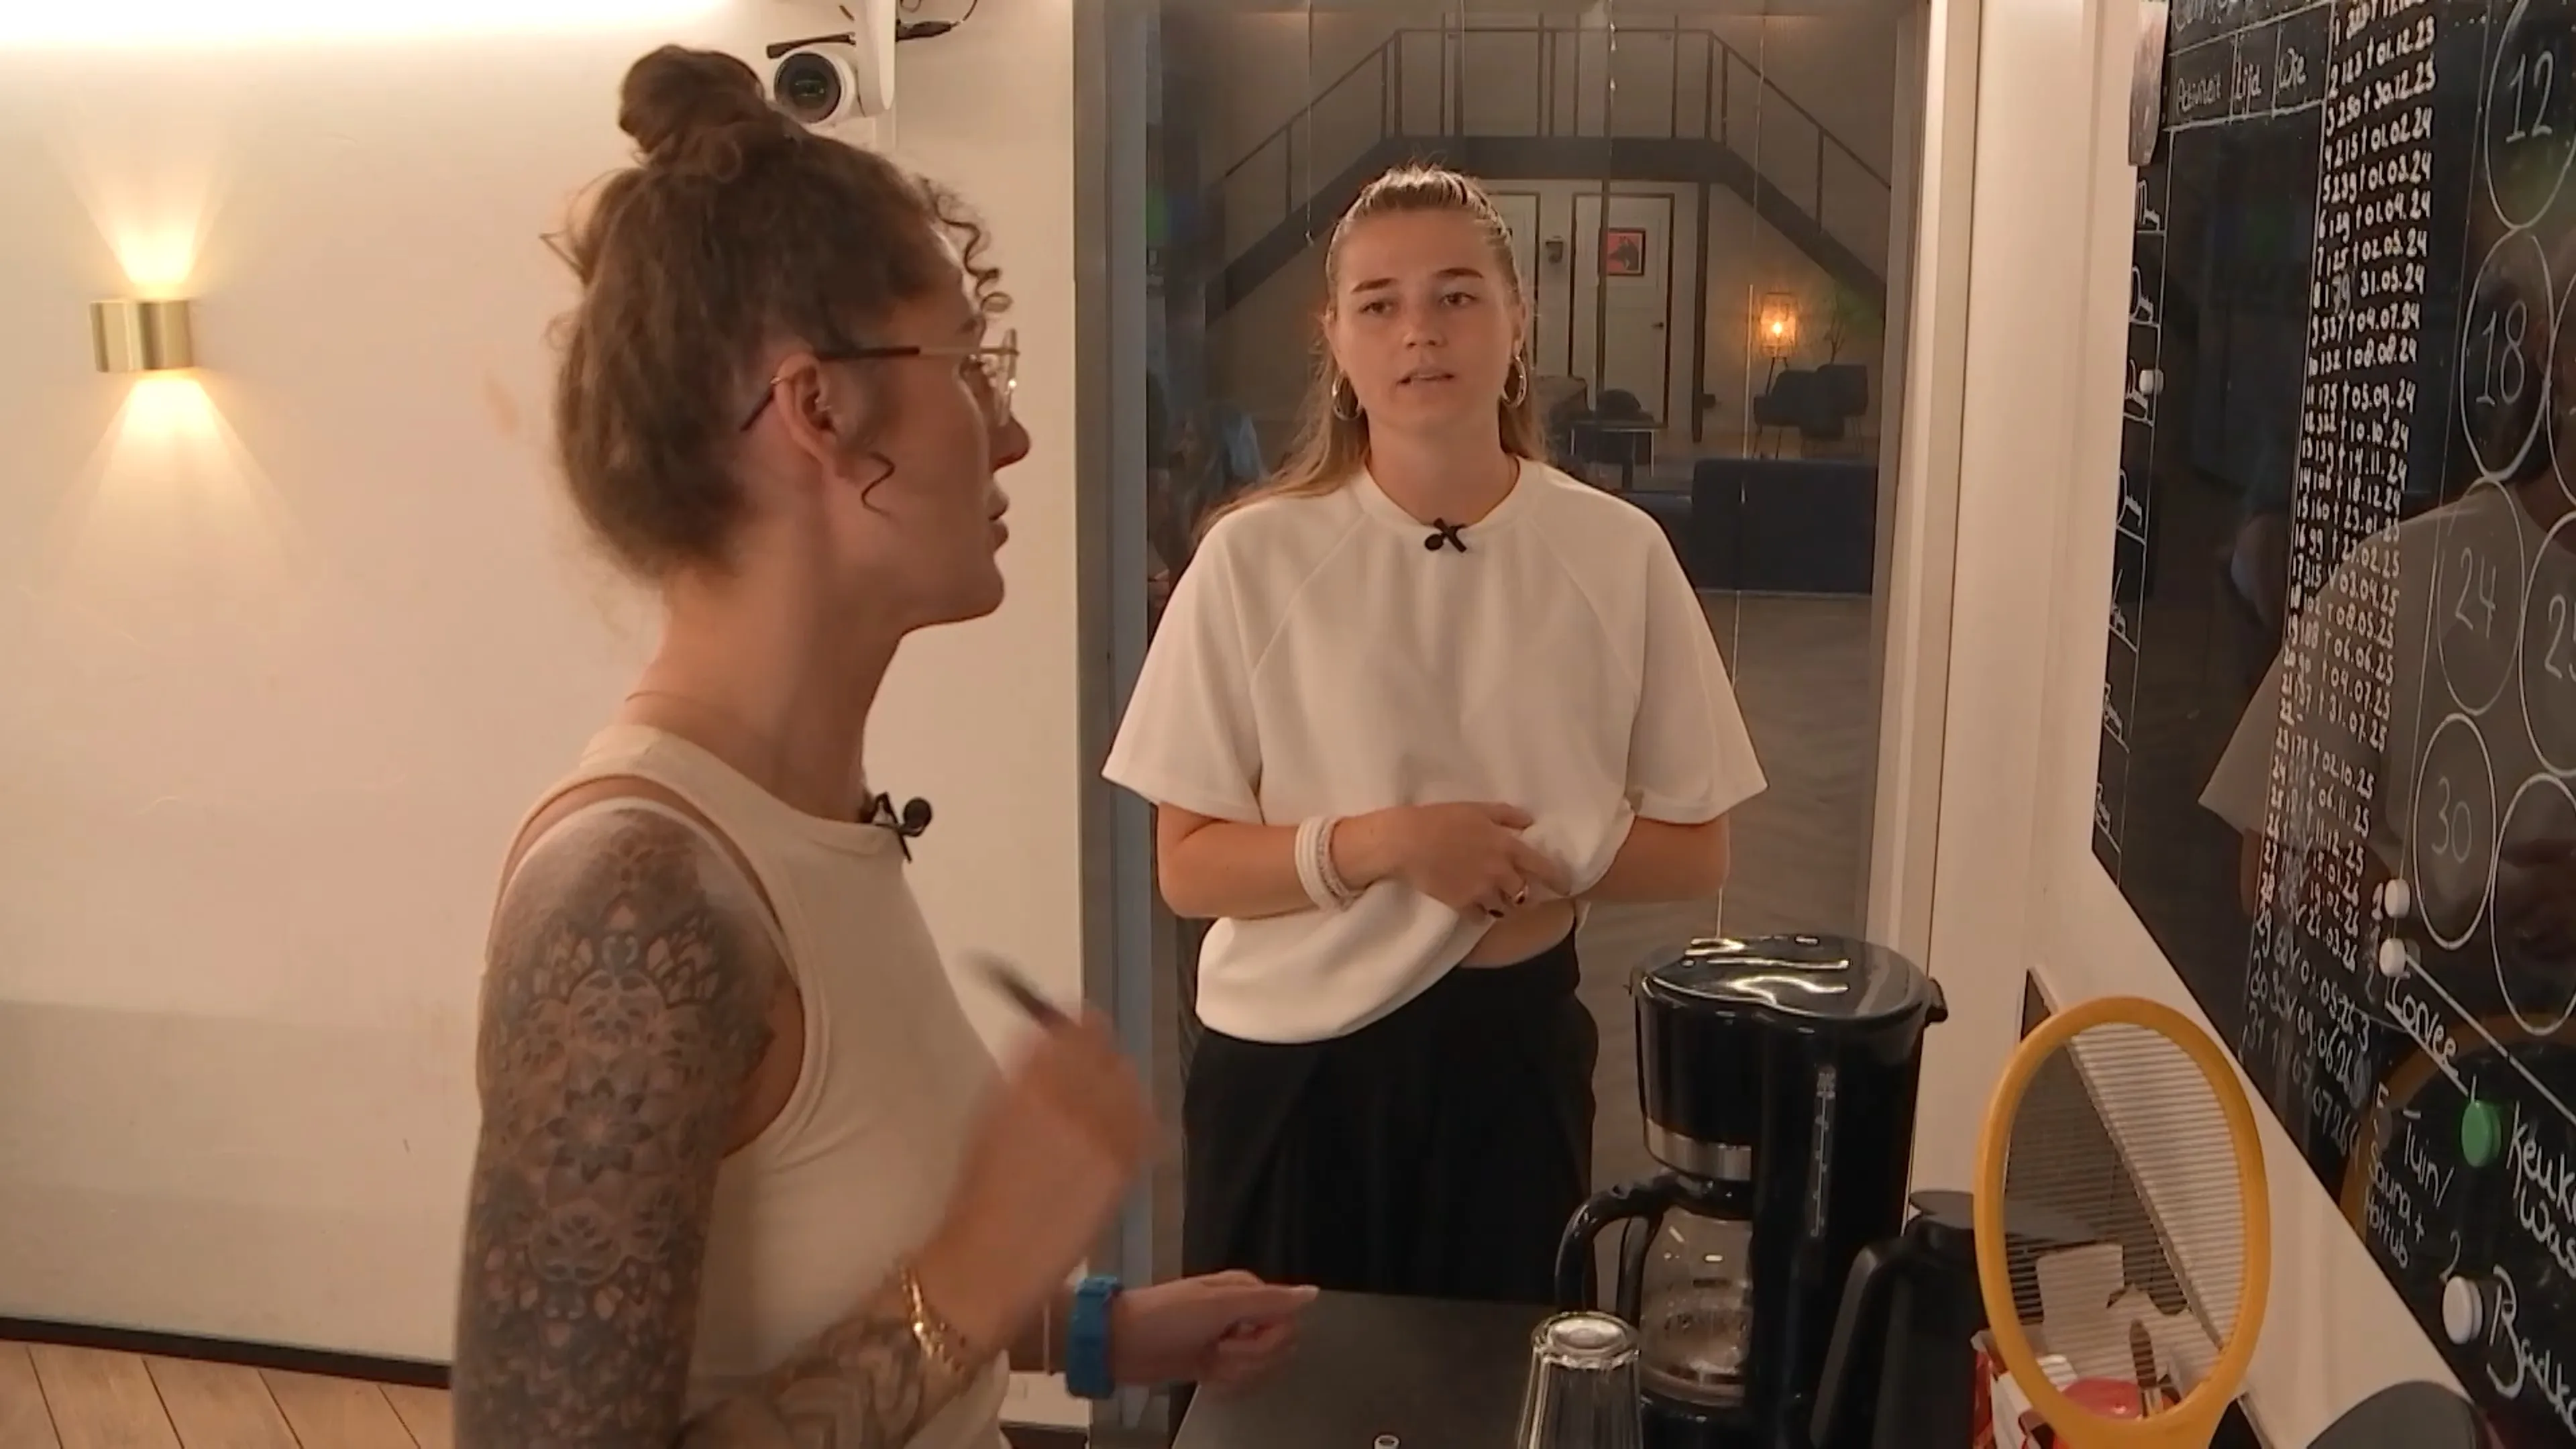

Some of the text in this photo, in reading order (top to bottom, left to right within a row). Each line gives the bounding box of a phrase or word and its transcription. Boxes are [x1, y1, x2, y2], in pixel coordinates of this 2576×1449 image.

[2376, 16, 2434, 66] 01.12.23
[2326, 107, 2335, 138] 3
[2373, 52, 2436, 110] 30.12.23
[2506, 50, 2555, 143] 12
[2324, 145, 2332, 171] 4
[2334, 131, 2358, 168] 215
[2371, 107, 2432, 152] 01.02.24
[2322, 174, 2331, 203] 5
[2368, 150, 2432, 191] 01.03.24
[2318, 209, 2326, 239] 6
[2365, 189, 2430, 227] 01.04.24
[2317, 246, 2324, 276] 7
[2361, 262, 2425, 298] 31.05.24
[2357, 301, 2420, 333] 04.07.24
[2320, 349, 2342, 376] 132
[2354, 333, 2417, 368] 08.08.24
[2476, 300, 2527, 406] 18
[2352, 378, 2416, 424] 05.09.24
[2350, 419, 2409, 453] 10.10.24
[2300, 468, 2310, 493] 14
[2349, 448, 2408, 494] 14.11.24
[2297, 493, 2308, 520] 15
[2311, 496, 2330, 521] 160
[2295, 523, 2306, 547] 16
[2309, 529, 2323, 561] 99
[2292, 553, 2304, 580] 17
[2455, 547, 2497, 638] 24
[2336, 602, 2394, 649] 08.05.25
[2544, 593, 2576, 682] 2
[2334, 636, 2394, 684] 06.06.25
[2330, 666, 2390, 721] 09.07.25
[2431, 777, 2472, 863] 30
